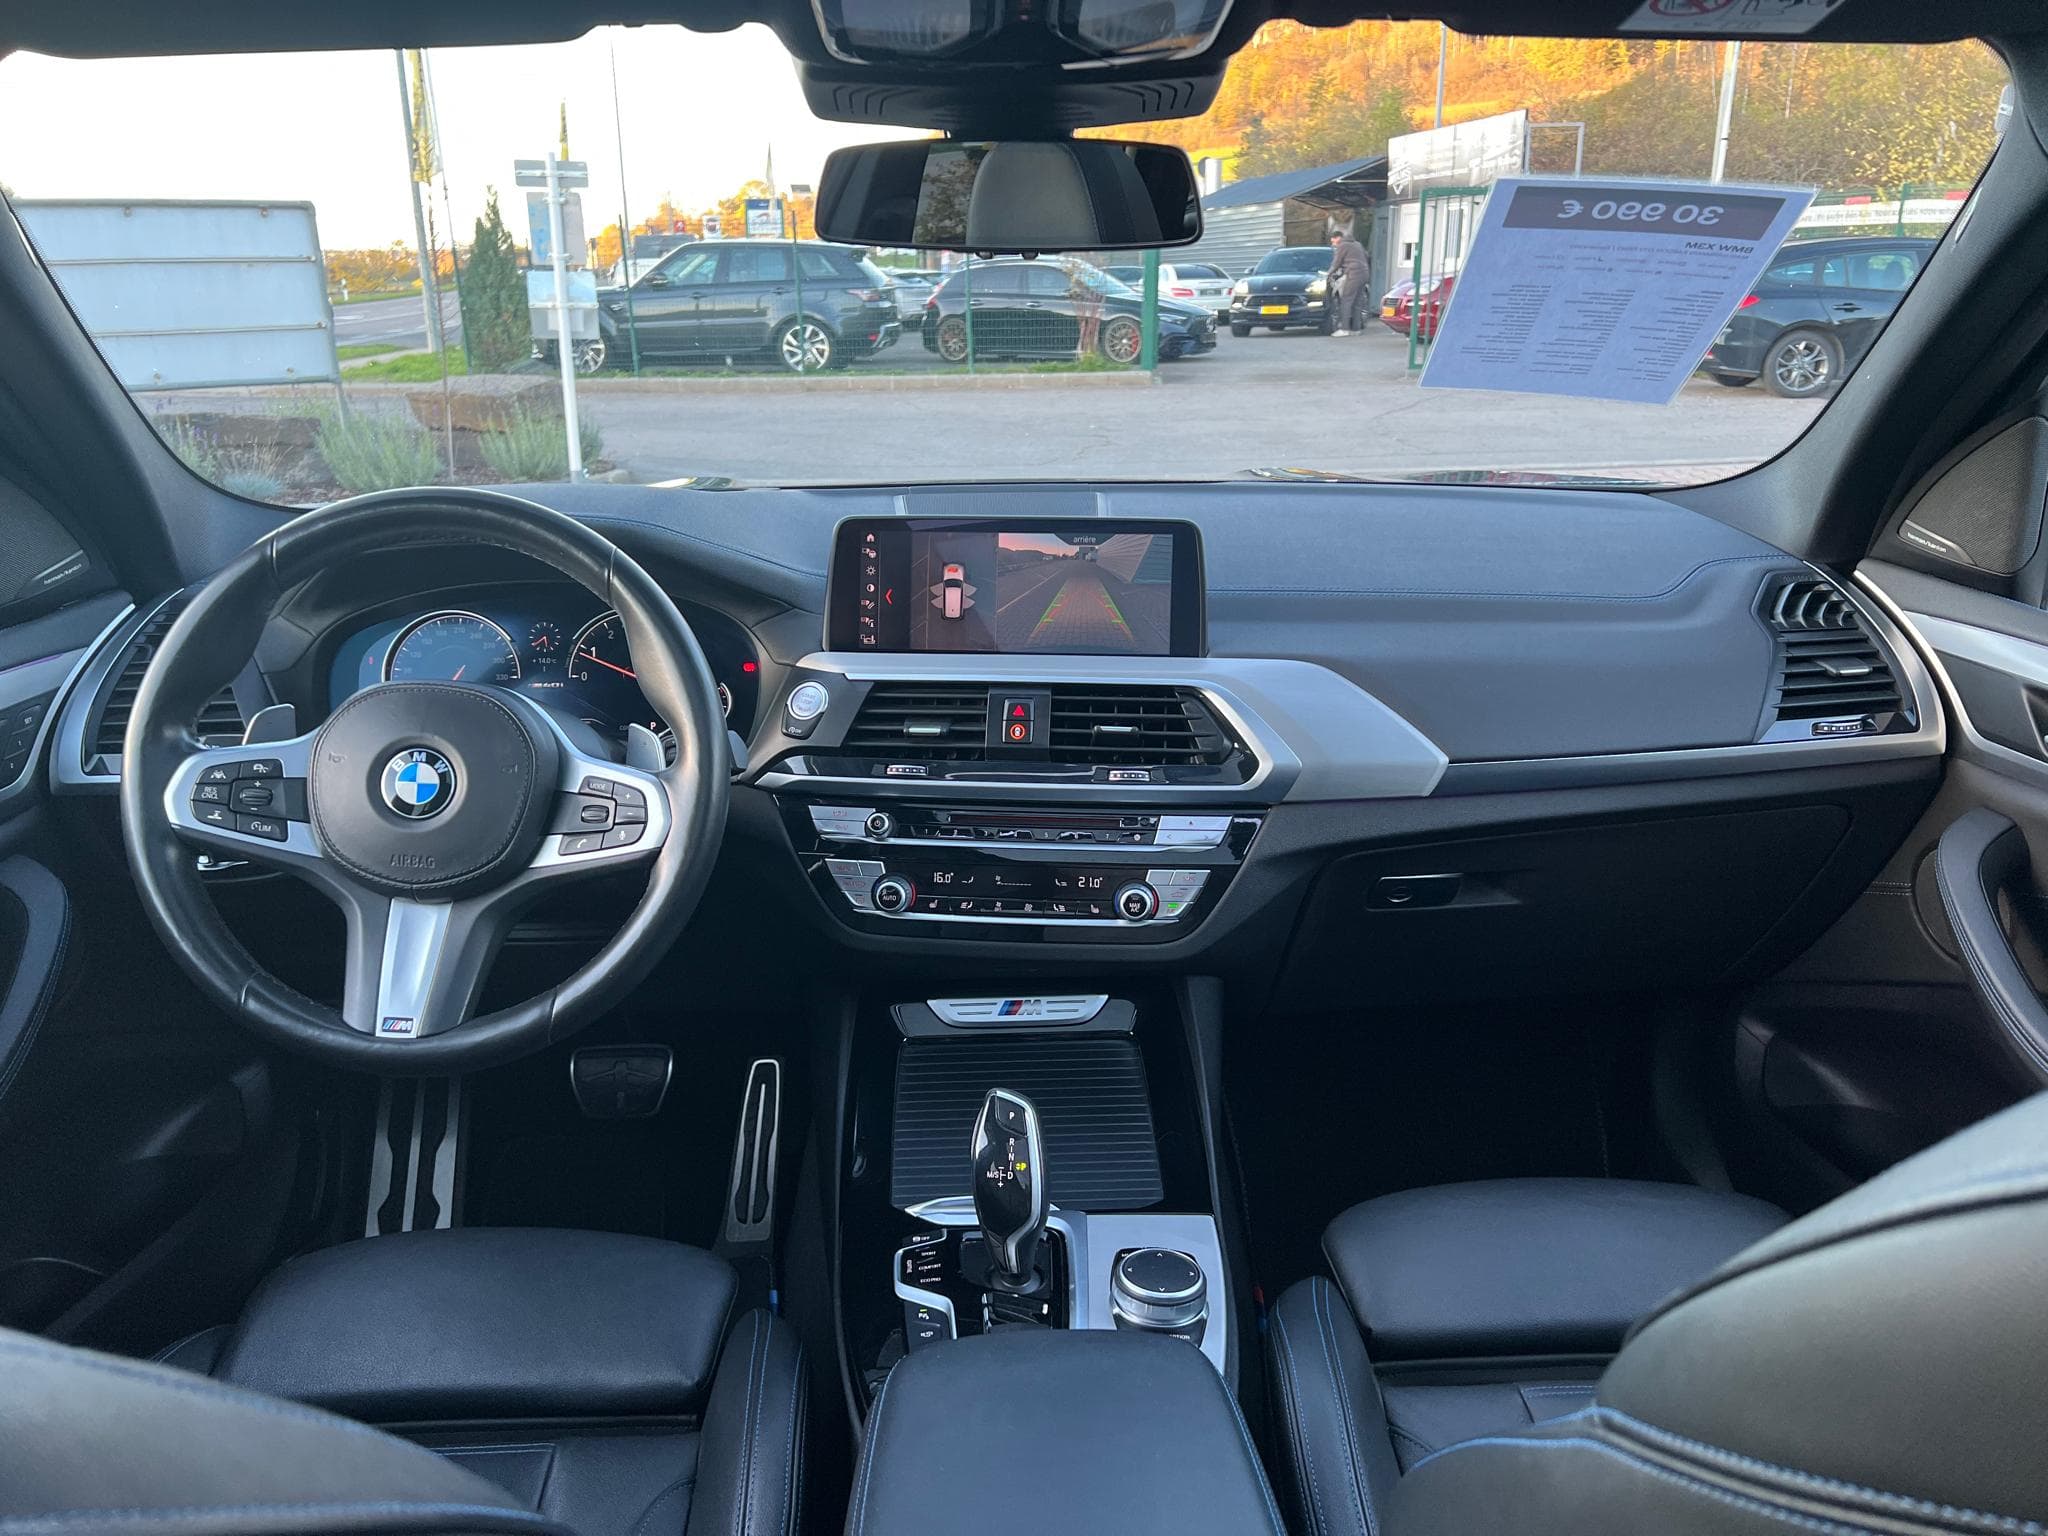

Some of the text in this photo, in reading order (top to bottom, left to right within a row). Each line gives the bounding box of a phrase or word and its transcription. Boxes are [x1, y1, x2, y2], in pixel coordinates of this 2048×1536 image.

[607, 630, 614, 639] 2
[590, 646, 596, 658] 1
[580, 671, 588, 681] 0
[650, 721, 657, 730] P
[391, 751, 448, 774] BMW
[204, 786, 218, 794] RES
[390, 854, 436, 869] AIRBAG
[1009, 1112, 1015, 1120] P
[1009, 1138, 1015, 1146] R
[1008, 1153, 1015, 1161] N
[986, 1171, 1014, 1180] M/S D
